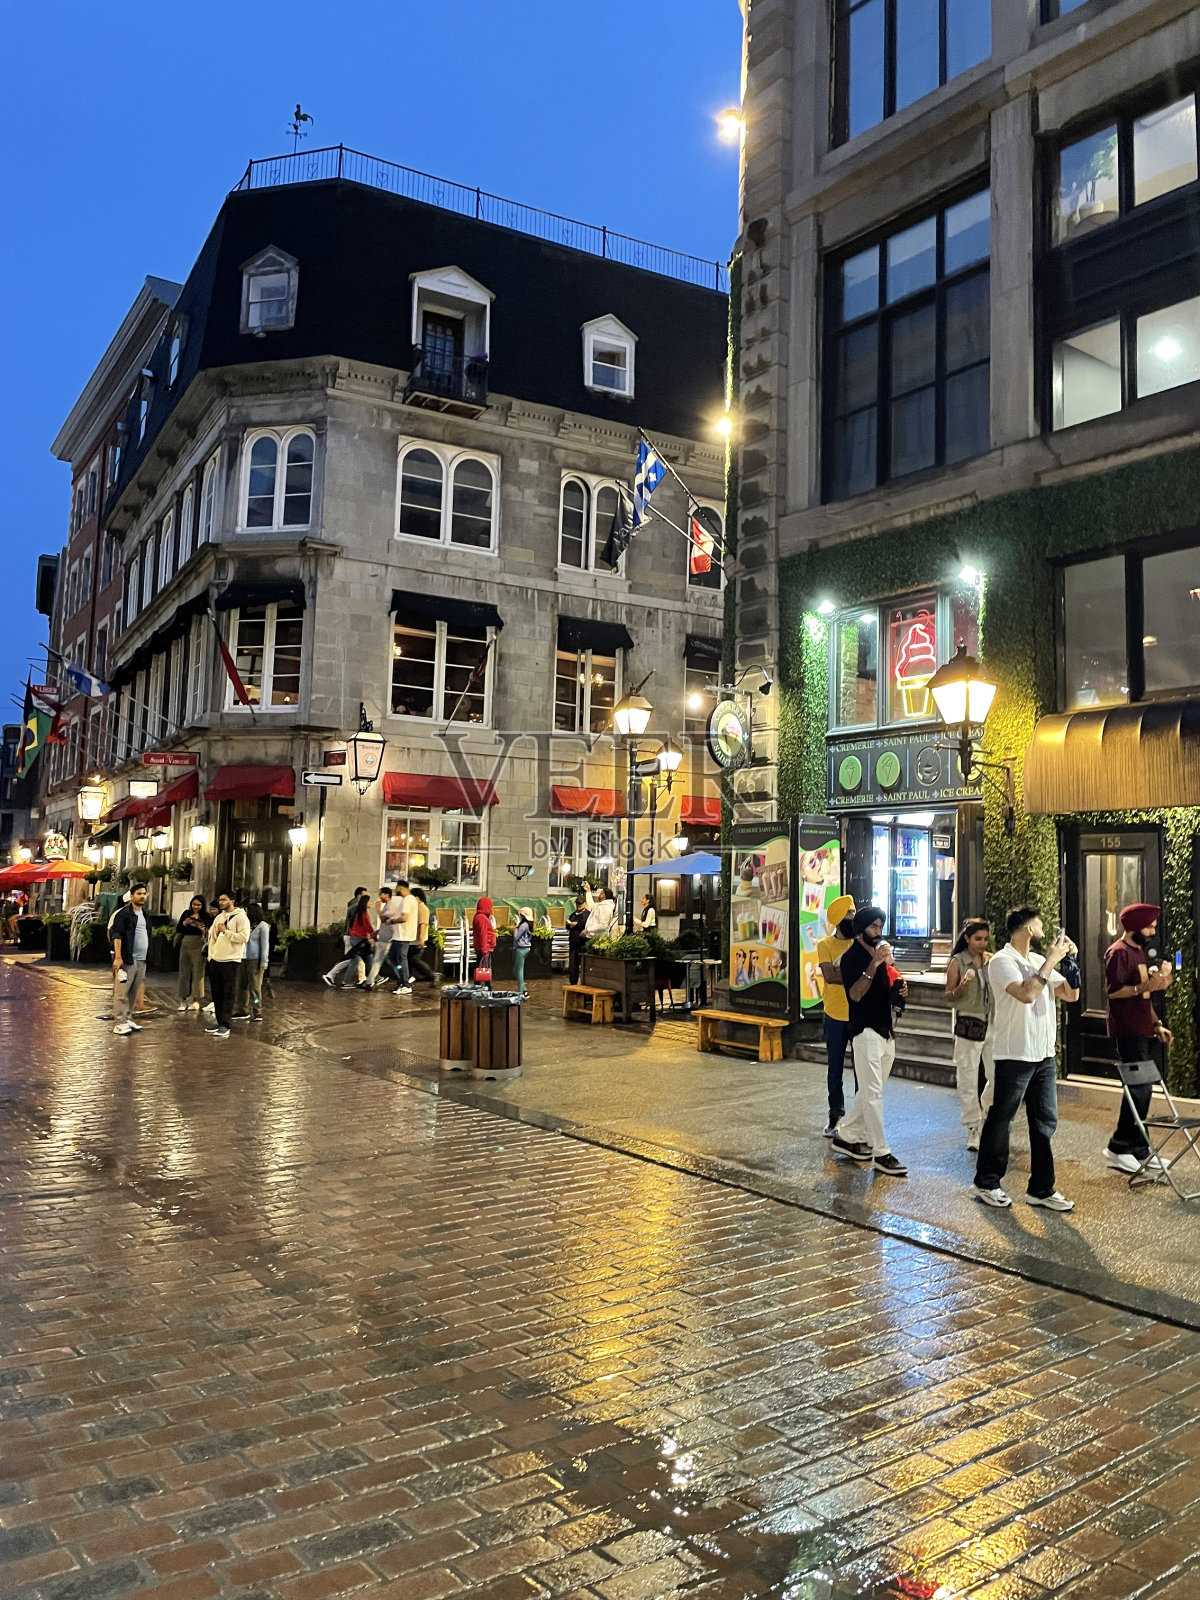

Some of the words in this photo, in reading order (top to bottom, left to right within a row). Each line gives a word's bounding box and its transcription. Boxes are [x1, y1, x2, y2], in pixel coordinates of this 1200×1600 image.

[836, 741, 875, 753] CREMERIE
[884, 737, 908, 747] SAINT
[909, 734, 931, 744] PAUL
[940, 730, 955, 741] ICE
[956, 728, 984, 739] CEA
[835, 794, 874, 805] CREMERIE
[883, 792, 907, 802] SAINT
[908, 790, 930, 800] PAUL
[939, 788, 954, 798] ICE
[1100, 836, 1120, 848] 155
